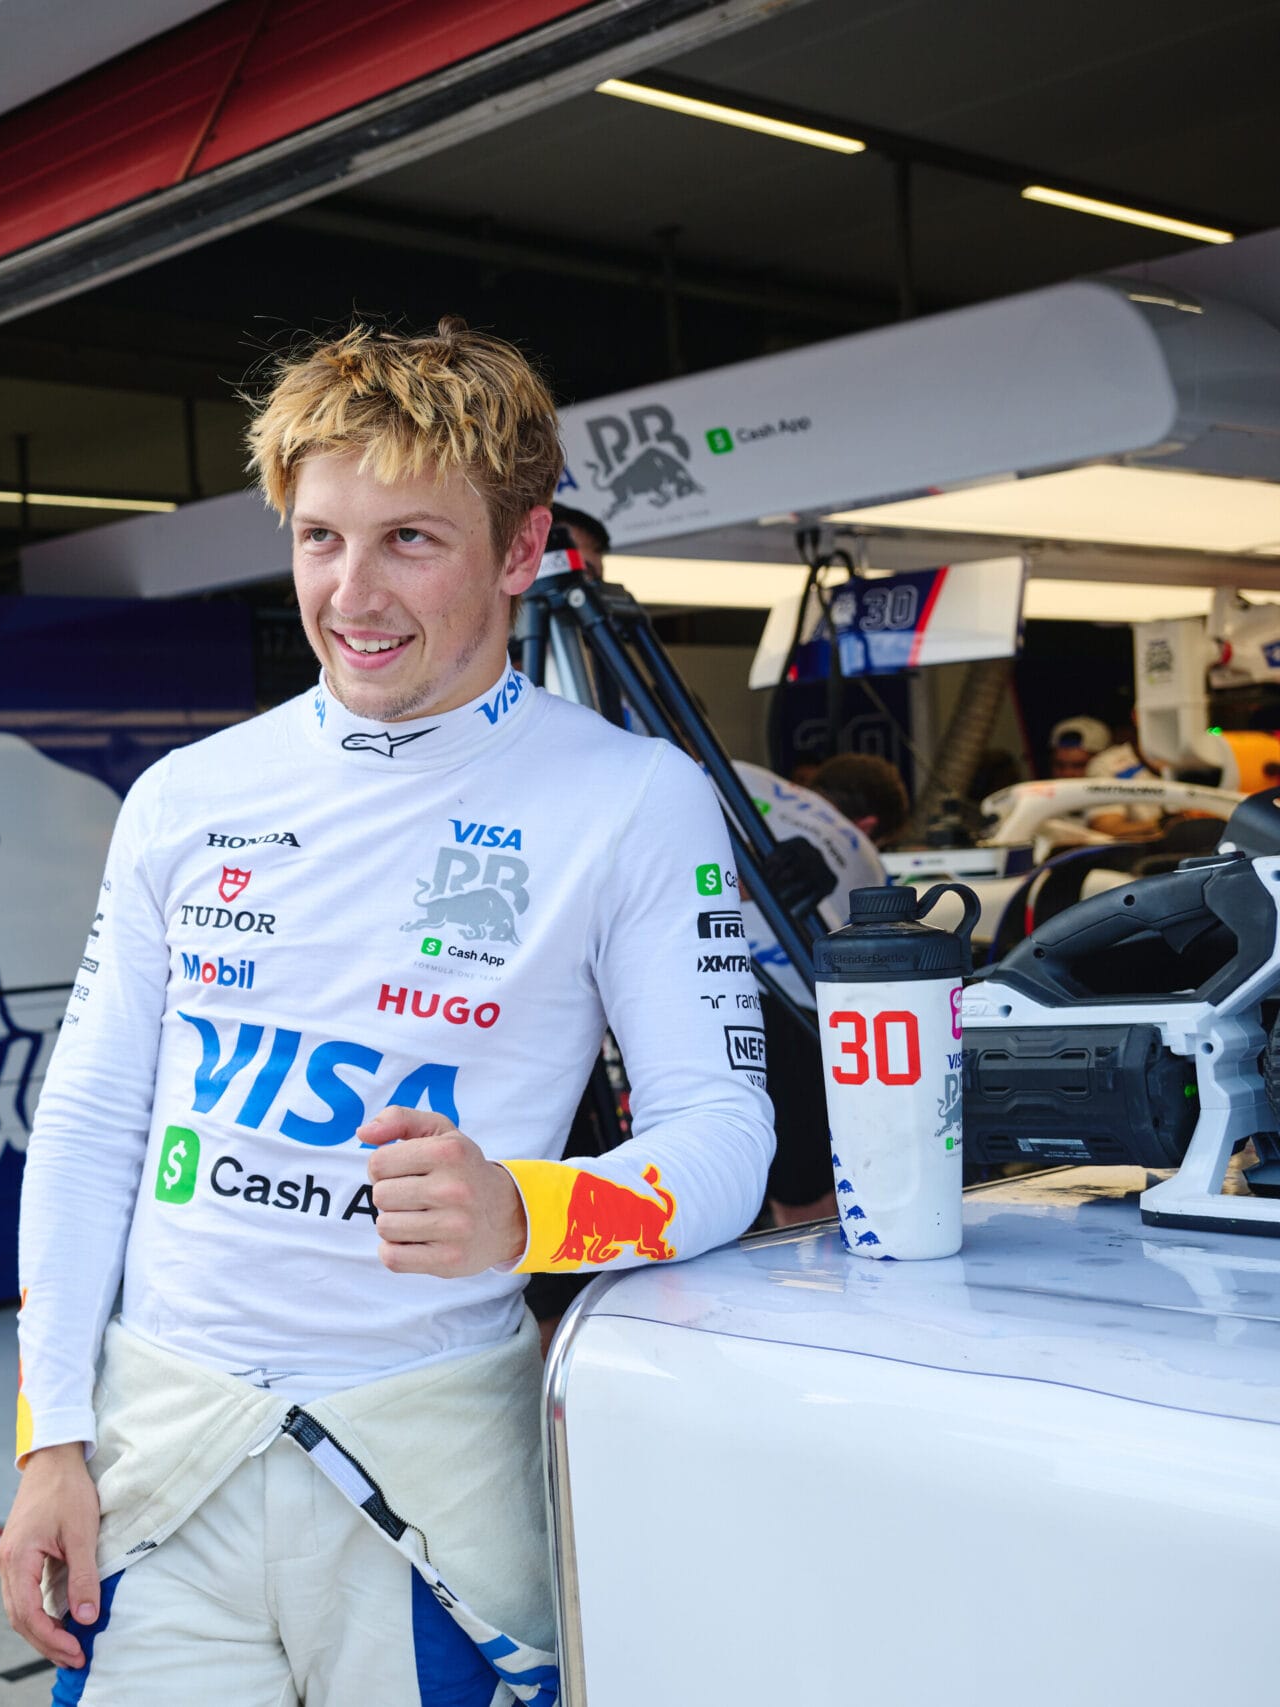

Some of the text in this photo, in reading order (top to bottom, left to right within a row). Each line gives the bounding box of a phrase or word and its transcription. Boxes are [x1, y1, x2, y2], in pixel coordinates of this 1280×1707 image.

[737, 421, 776, 444] Cash
[779, 412, 812, 440] App
[206, 831, 301, 849] HONDA
[448, 818, 522, 851] VISA
[181, 904, 276, 935] TUDOR
[180, 951, 256, 990] Mobil
[447, 946, 477, 961] Cash
[479, 953, 505, 967] App
[377, 984, 500, 1029] HUGO
[828, 1010, 921, 1086] 30
[209, 1155, 331, 1221] Cash
